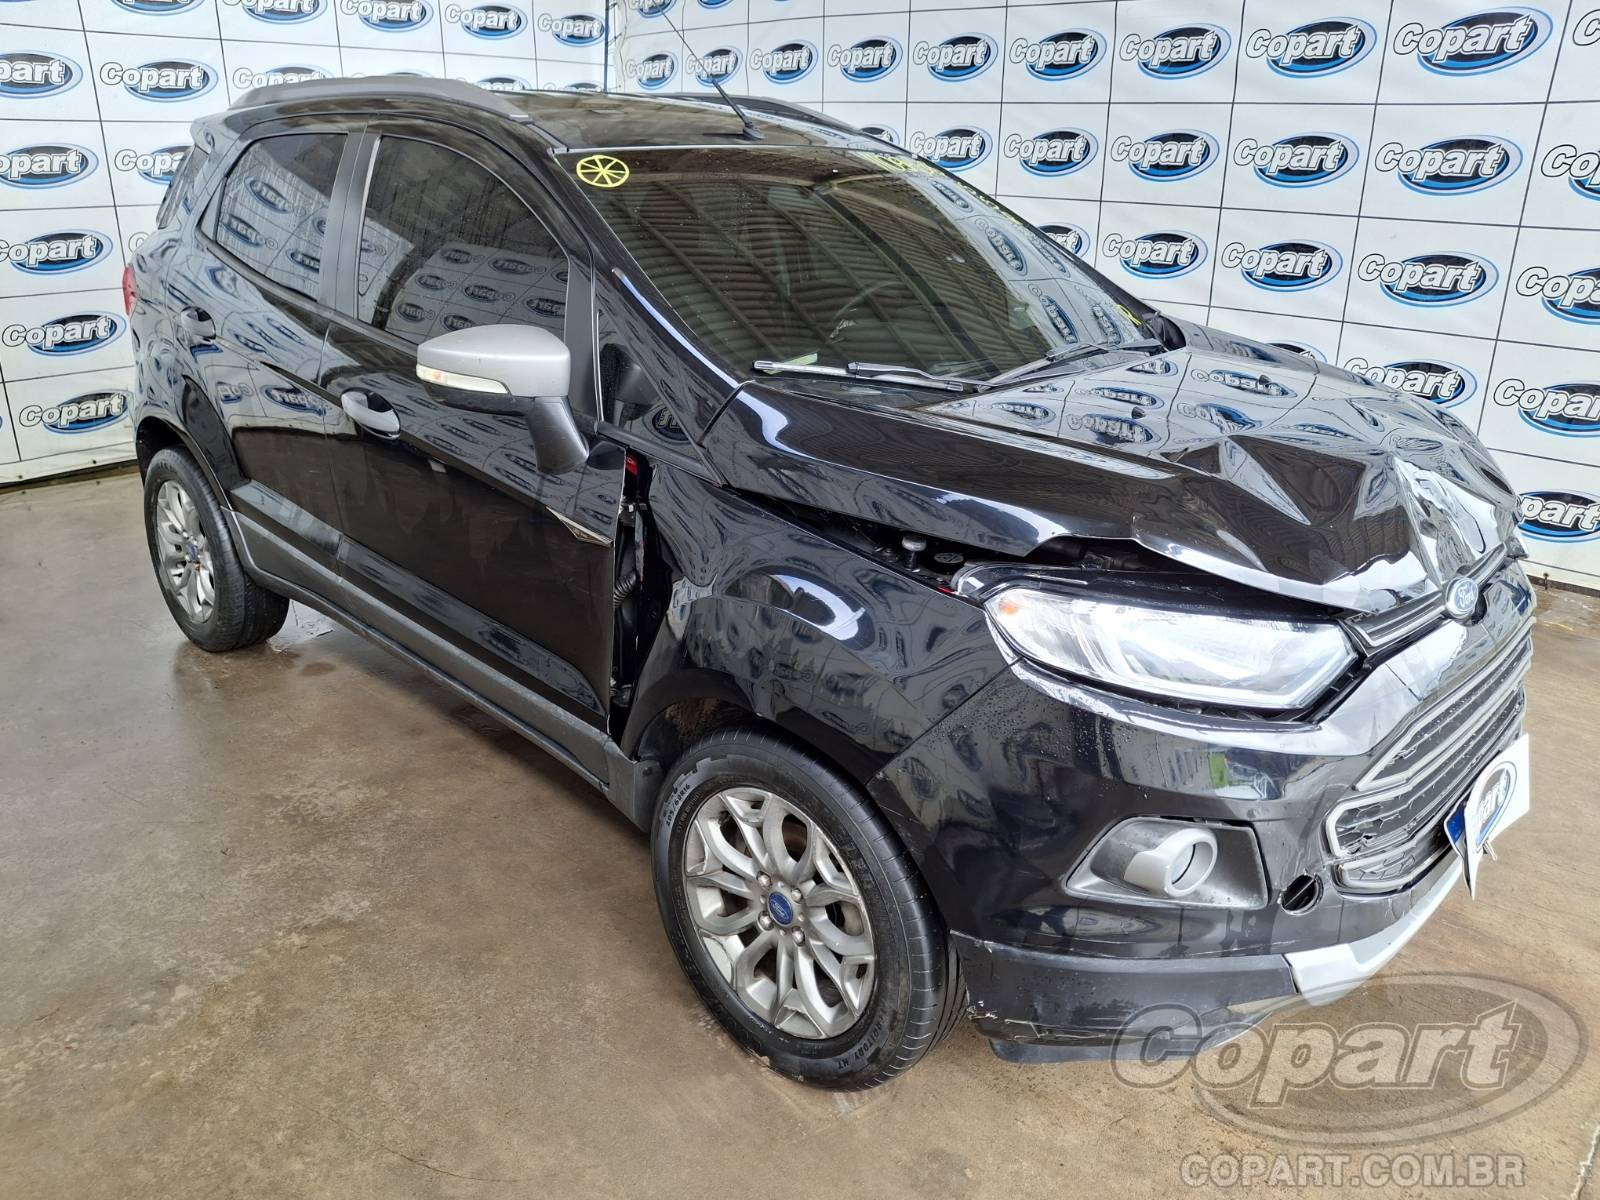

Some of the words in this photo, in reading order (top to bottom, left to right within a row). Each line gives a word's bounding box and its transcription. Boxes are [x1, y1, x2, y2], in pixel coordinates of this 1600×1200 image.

[340, 0, 422, 23] Copart
[445, 5, 517, 31] Copart
[538, 13, 602, 39] Copart
[913, 38, 989, 71] Copart
[1009, 32, 1095, 69] Copart
[1119, 31, 1219, 67] Copart
[1245, 24, 1361, 65] Copart
[1393, 14, 1533, 63] Copart
[625, 56, 673, 81] Copart
[686, 51, 738, 80] Copart
[750, 43, 811, 76] Copart
[827, 41, 895, 73] Copart
[100, 62, 203, 91] Copart
[909, 131, 982, 160] Copart
[1004, 133, 1092, 167] Copart
[1111, 136, 1207, 170] Copart
[1233, 138, 1343, 175] Copart
[1375, 142, 1504, 181] Copart
[1103, 232, 1194, 267] Copart
[1221, 242, 1327, 277] Copart
[1358, 254, 1480, 292] Copart
[2, 315, 111, 349] Copart
[19, 391, 125, 427] Copart
[1519, 496, 1600, 531] part
